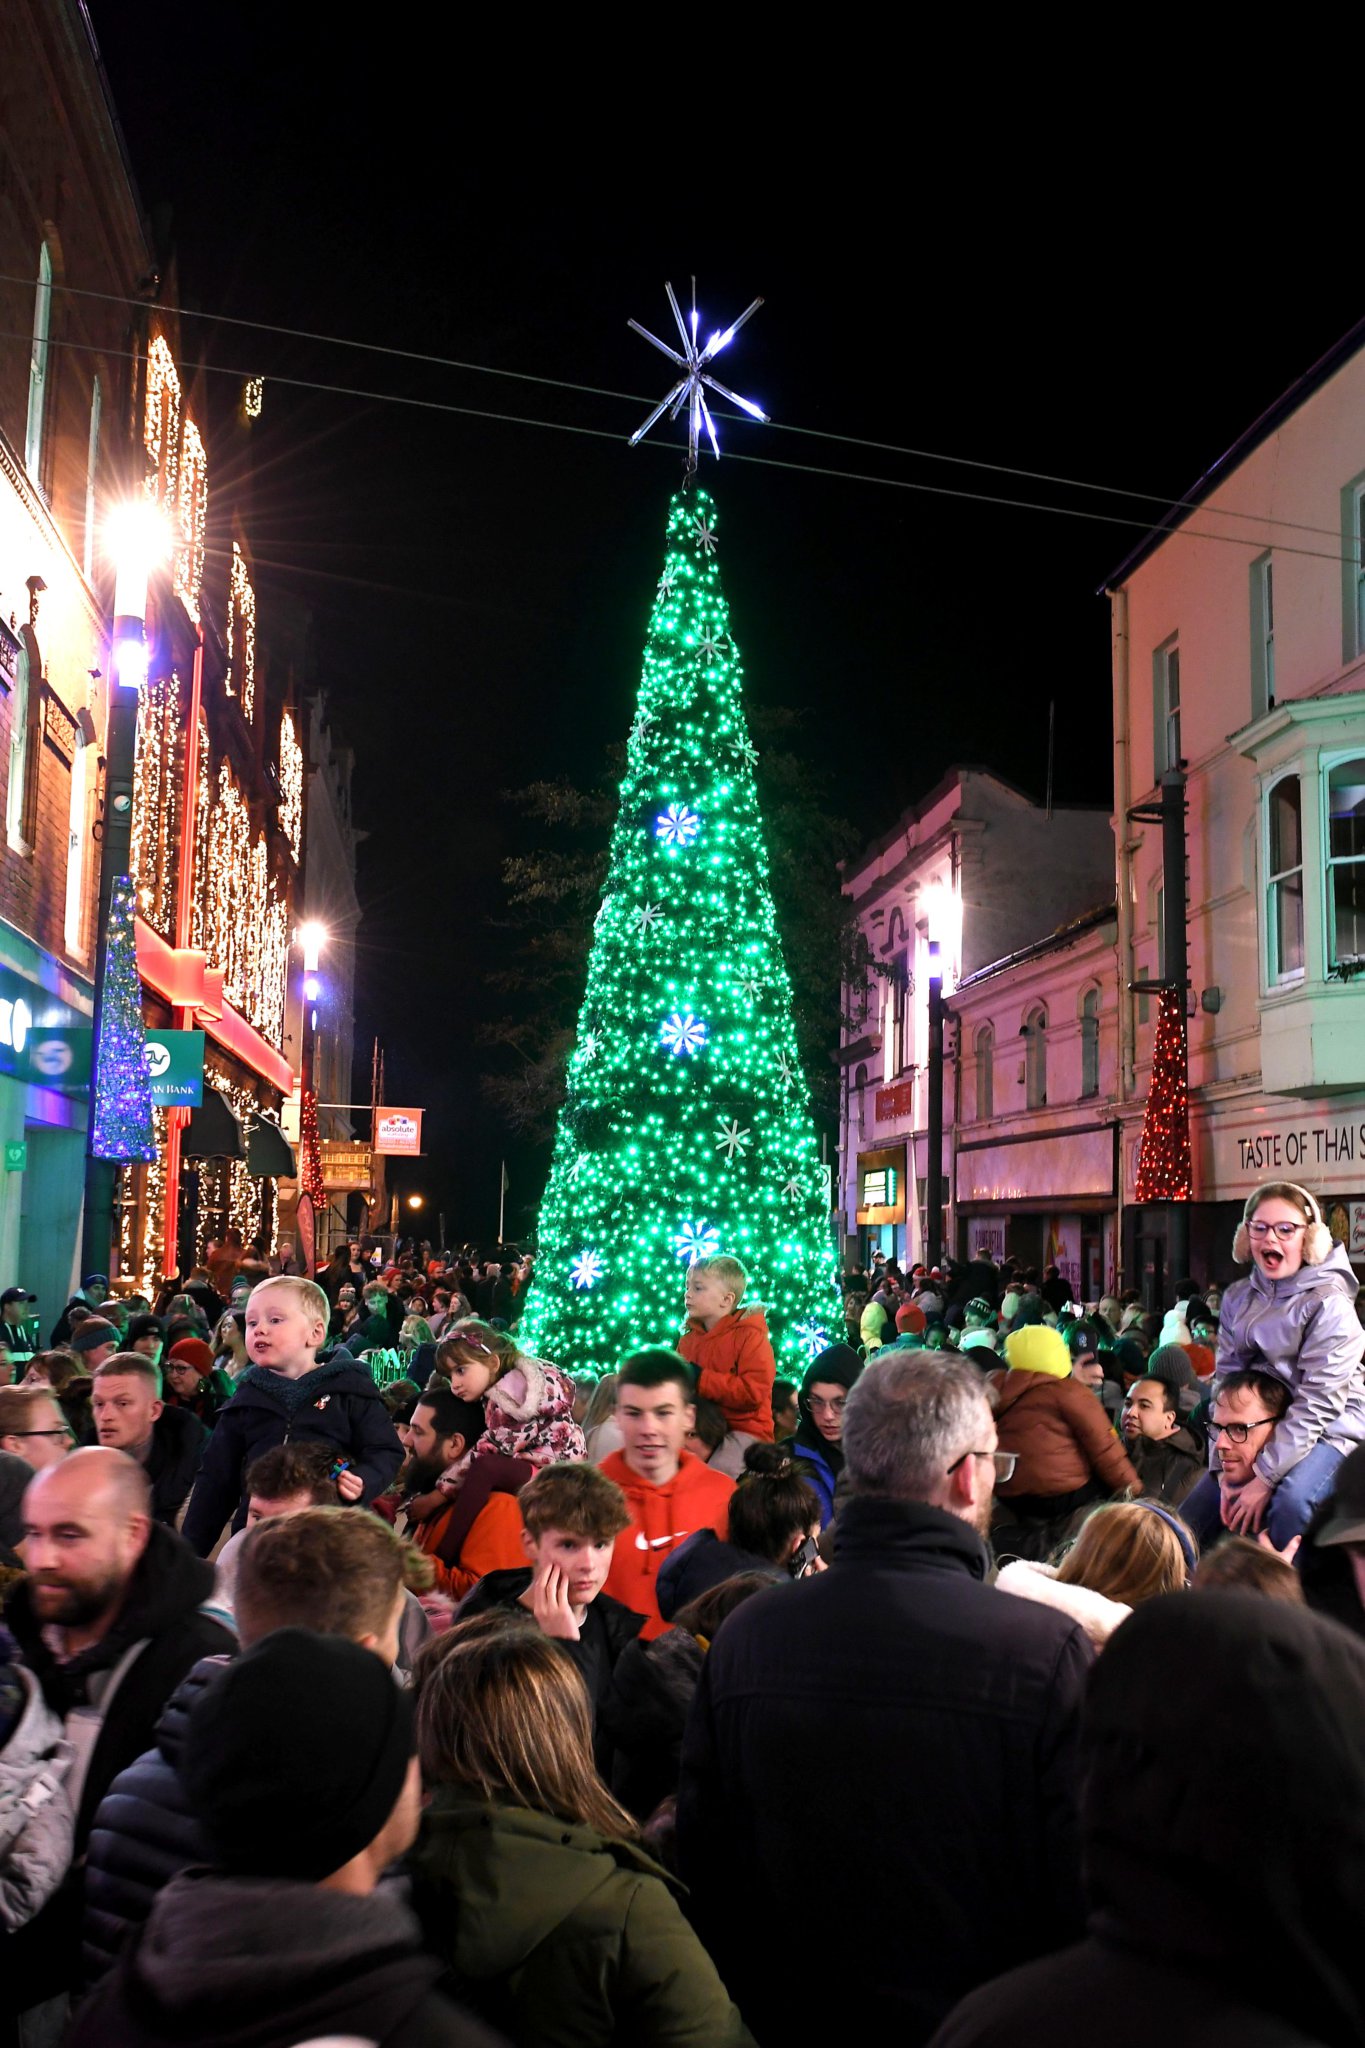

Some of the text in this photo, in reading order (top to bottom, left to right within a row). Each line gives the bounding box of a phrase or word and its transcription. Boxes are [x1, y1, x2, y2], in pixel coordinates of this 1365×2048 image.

[166, 1084, 194, 1095] BANK
[381, 1125, 415, 1133] absolute
[1237, 1134, 1281, 1170] TASTE
[1285, 1131, 1308, 1166] OF
[1312, 1125, 1354, 1163] THAI
